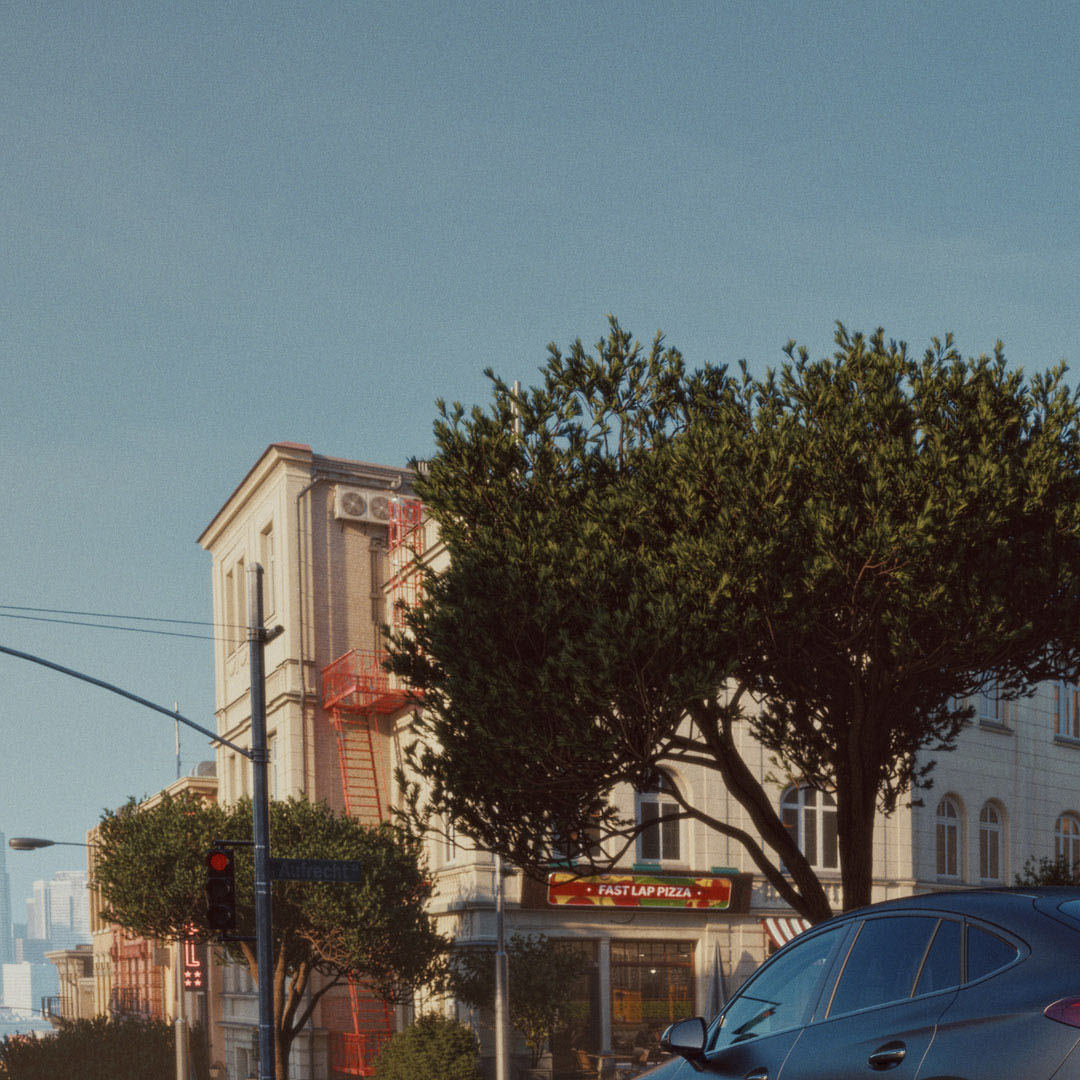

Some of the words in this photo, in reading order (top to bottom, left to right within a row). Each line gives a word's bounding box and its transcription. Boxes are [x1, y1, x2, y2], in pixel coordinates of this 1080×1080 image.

[598, 884, 630, 896] FAST
[631, 885, 655, 897] LAP
[656, 886, 692, 898] PIZZA
